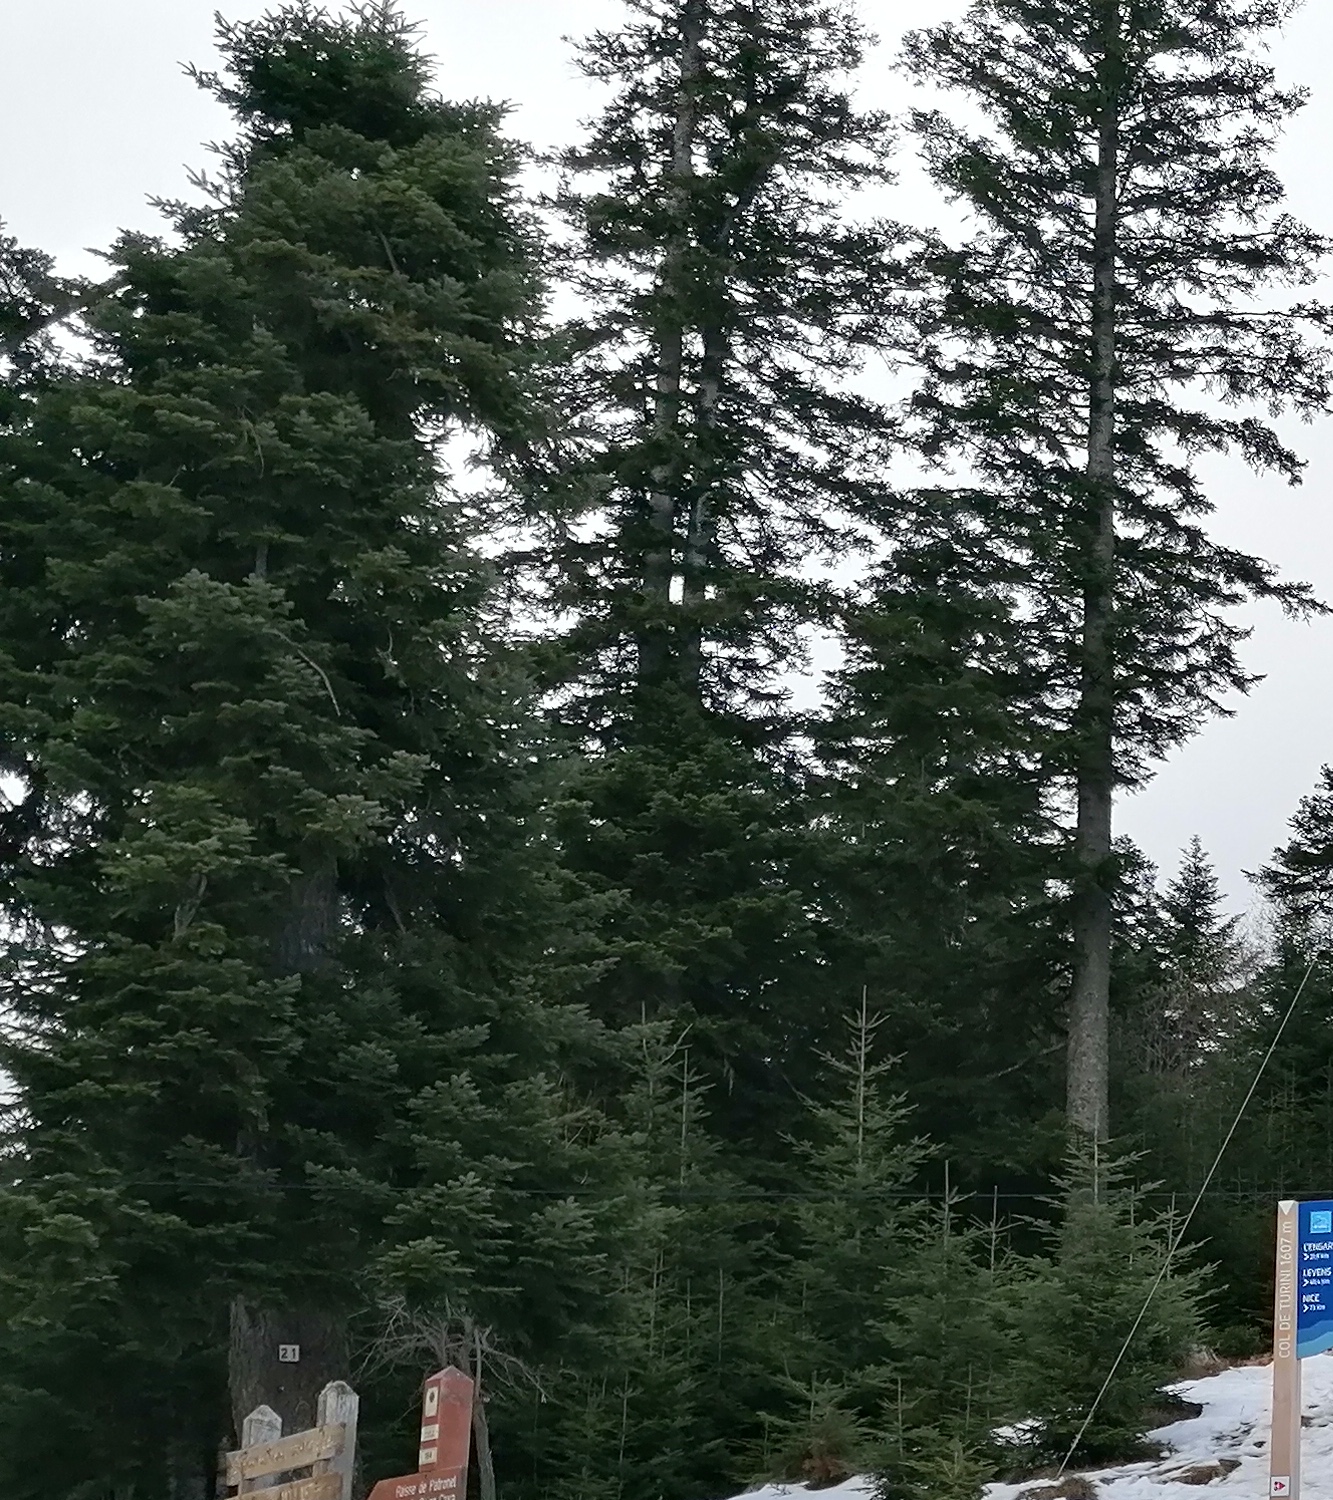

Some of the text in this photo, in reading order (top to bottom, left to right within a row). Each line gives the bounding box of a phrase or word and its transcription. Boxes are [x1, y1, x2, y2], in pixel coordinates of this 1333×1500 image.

[1302, 1267, 1332, 1277] LEVENS
[1278, 1221, 1293, 1359] COL DE TURINI 1607 m
[1302, 1293, 1320, 1303] NICE
[280, 1347, 297, 1360] 21
[418, 1481, 428, 1494] de
